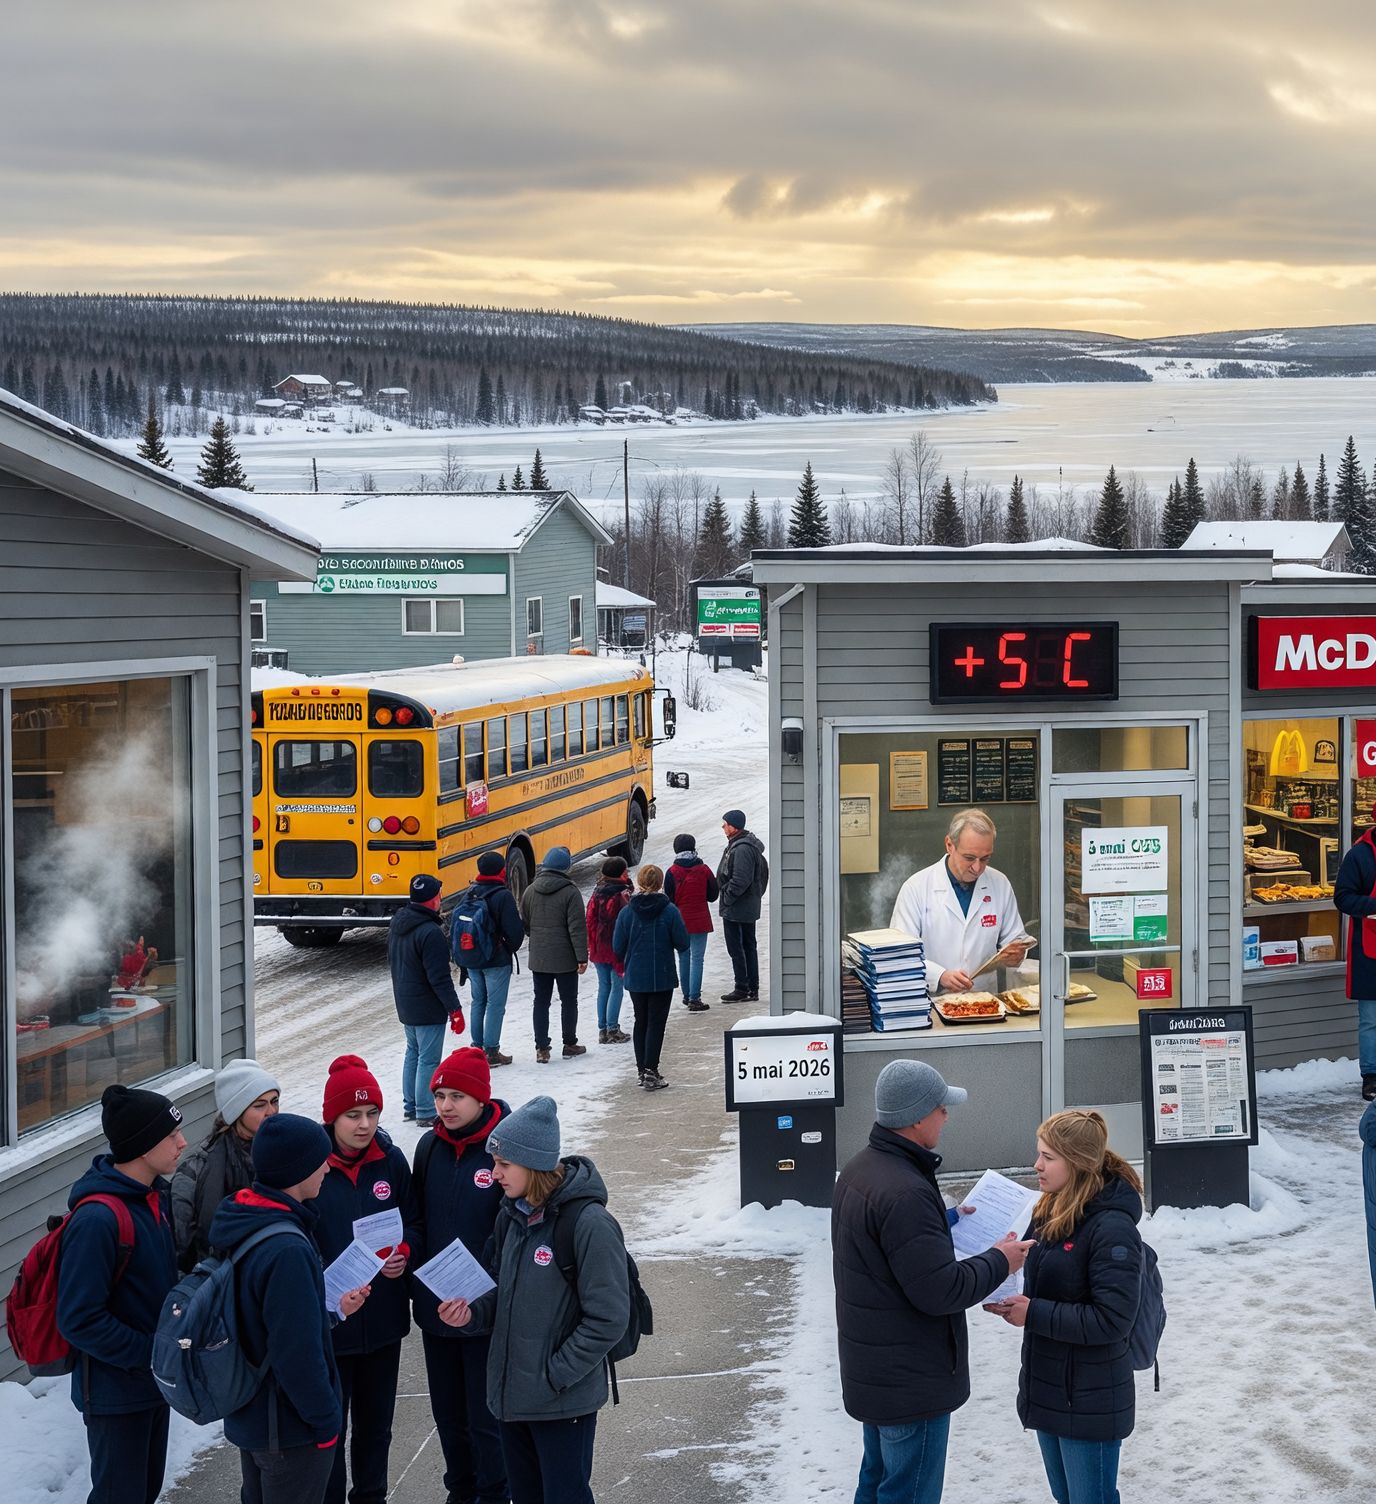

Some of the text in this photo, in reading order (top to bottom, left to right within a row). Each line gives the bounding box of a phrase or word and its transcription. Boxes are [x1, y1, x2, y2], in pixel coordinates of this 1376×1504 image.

[1063, 632, 1092, 688] C
[738, 1058, 831, 1080] 5 mai 2026
